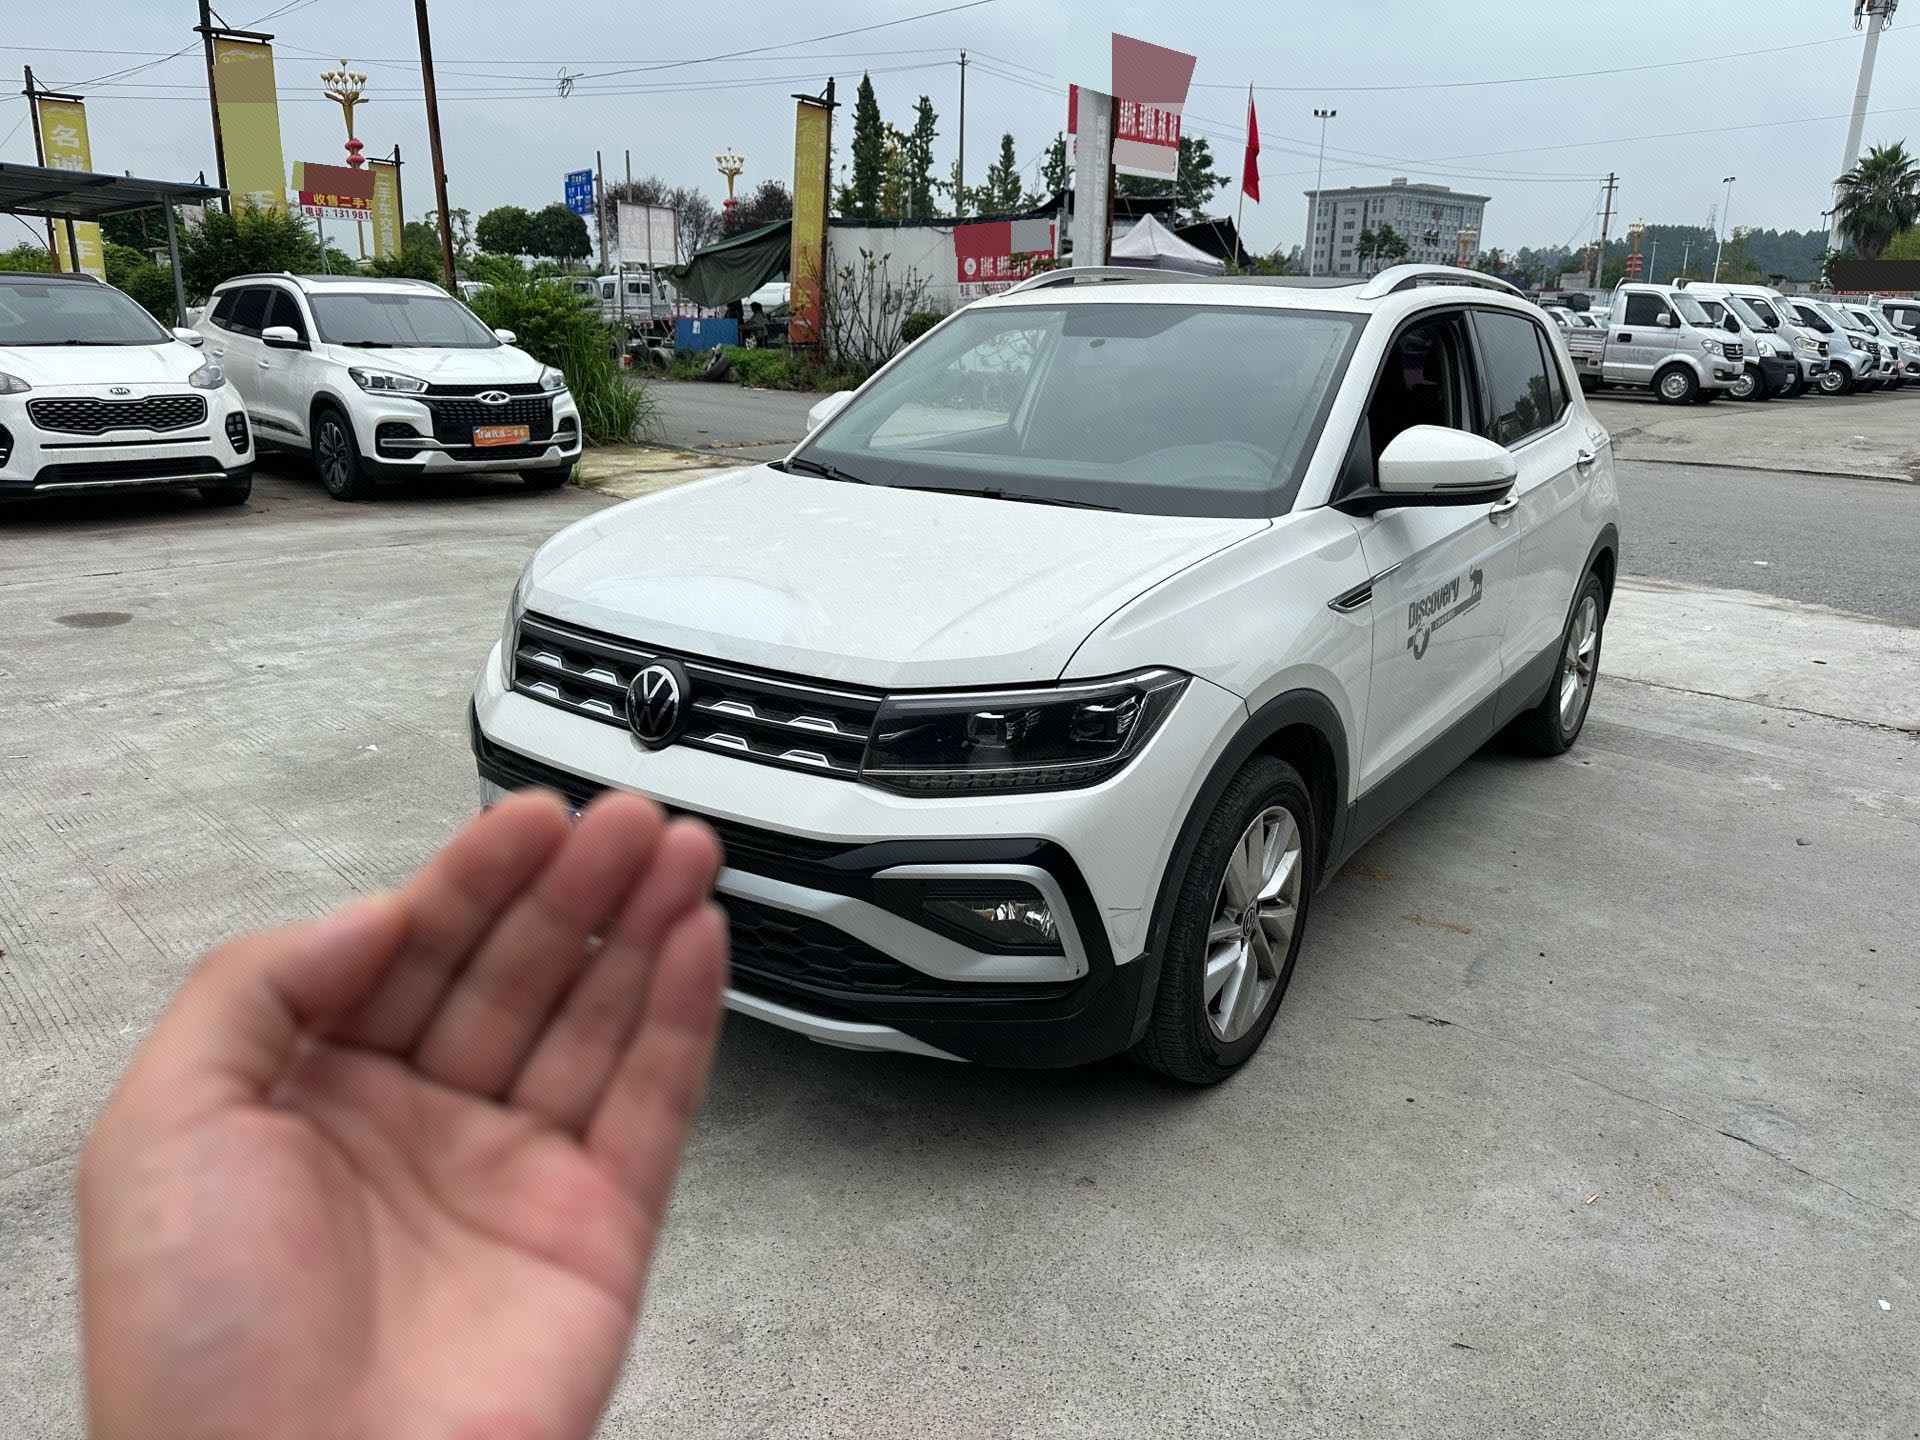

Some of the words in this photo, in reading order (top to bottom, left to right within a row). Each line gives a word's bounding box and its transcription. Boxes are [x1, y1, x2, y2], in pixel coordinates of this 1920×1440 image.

[797, 110, 820, 309] 高价收购货车
